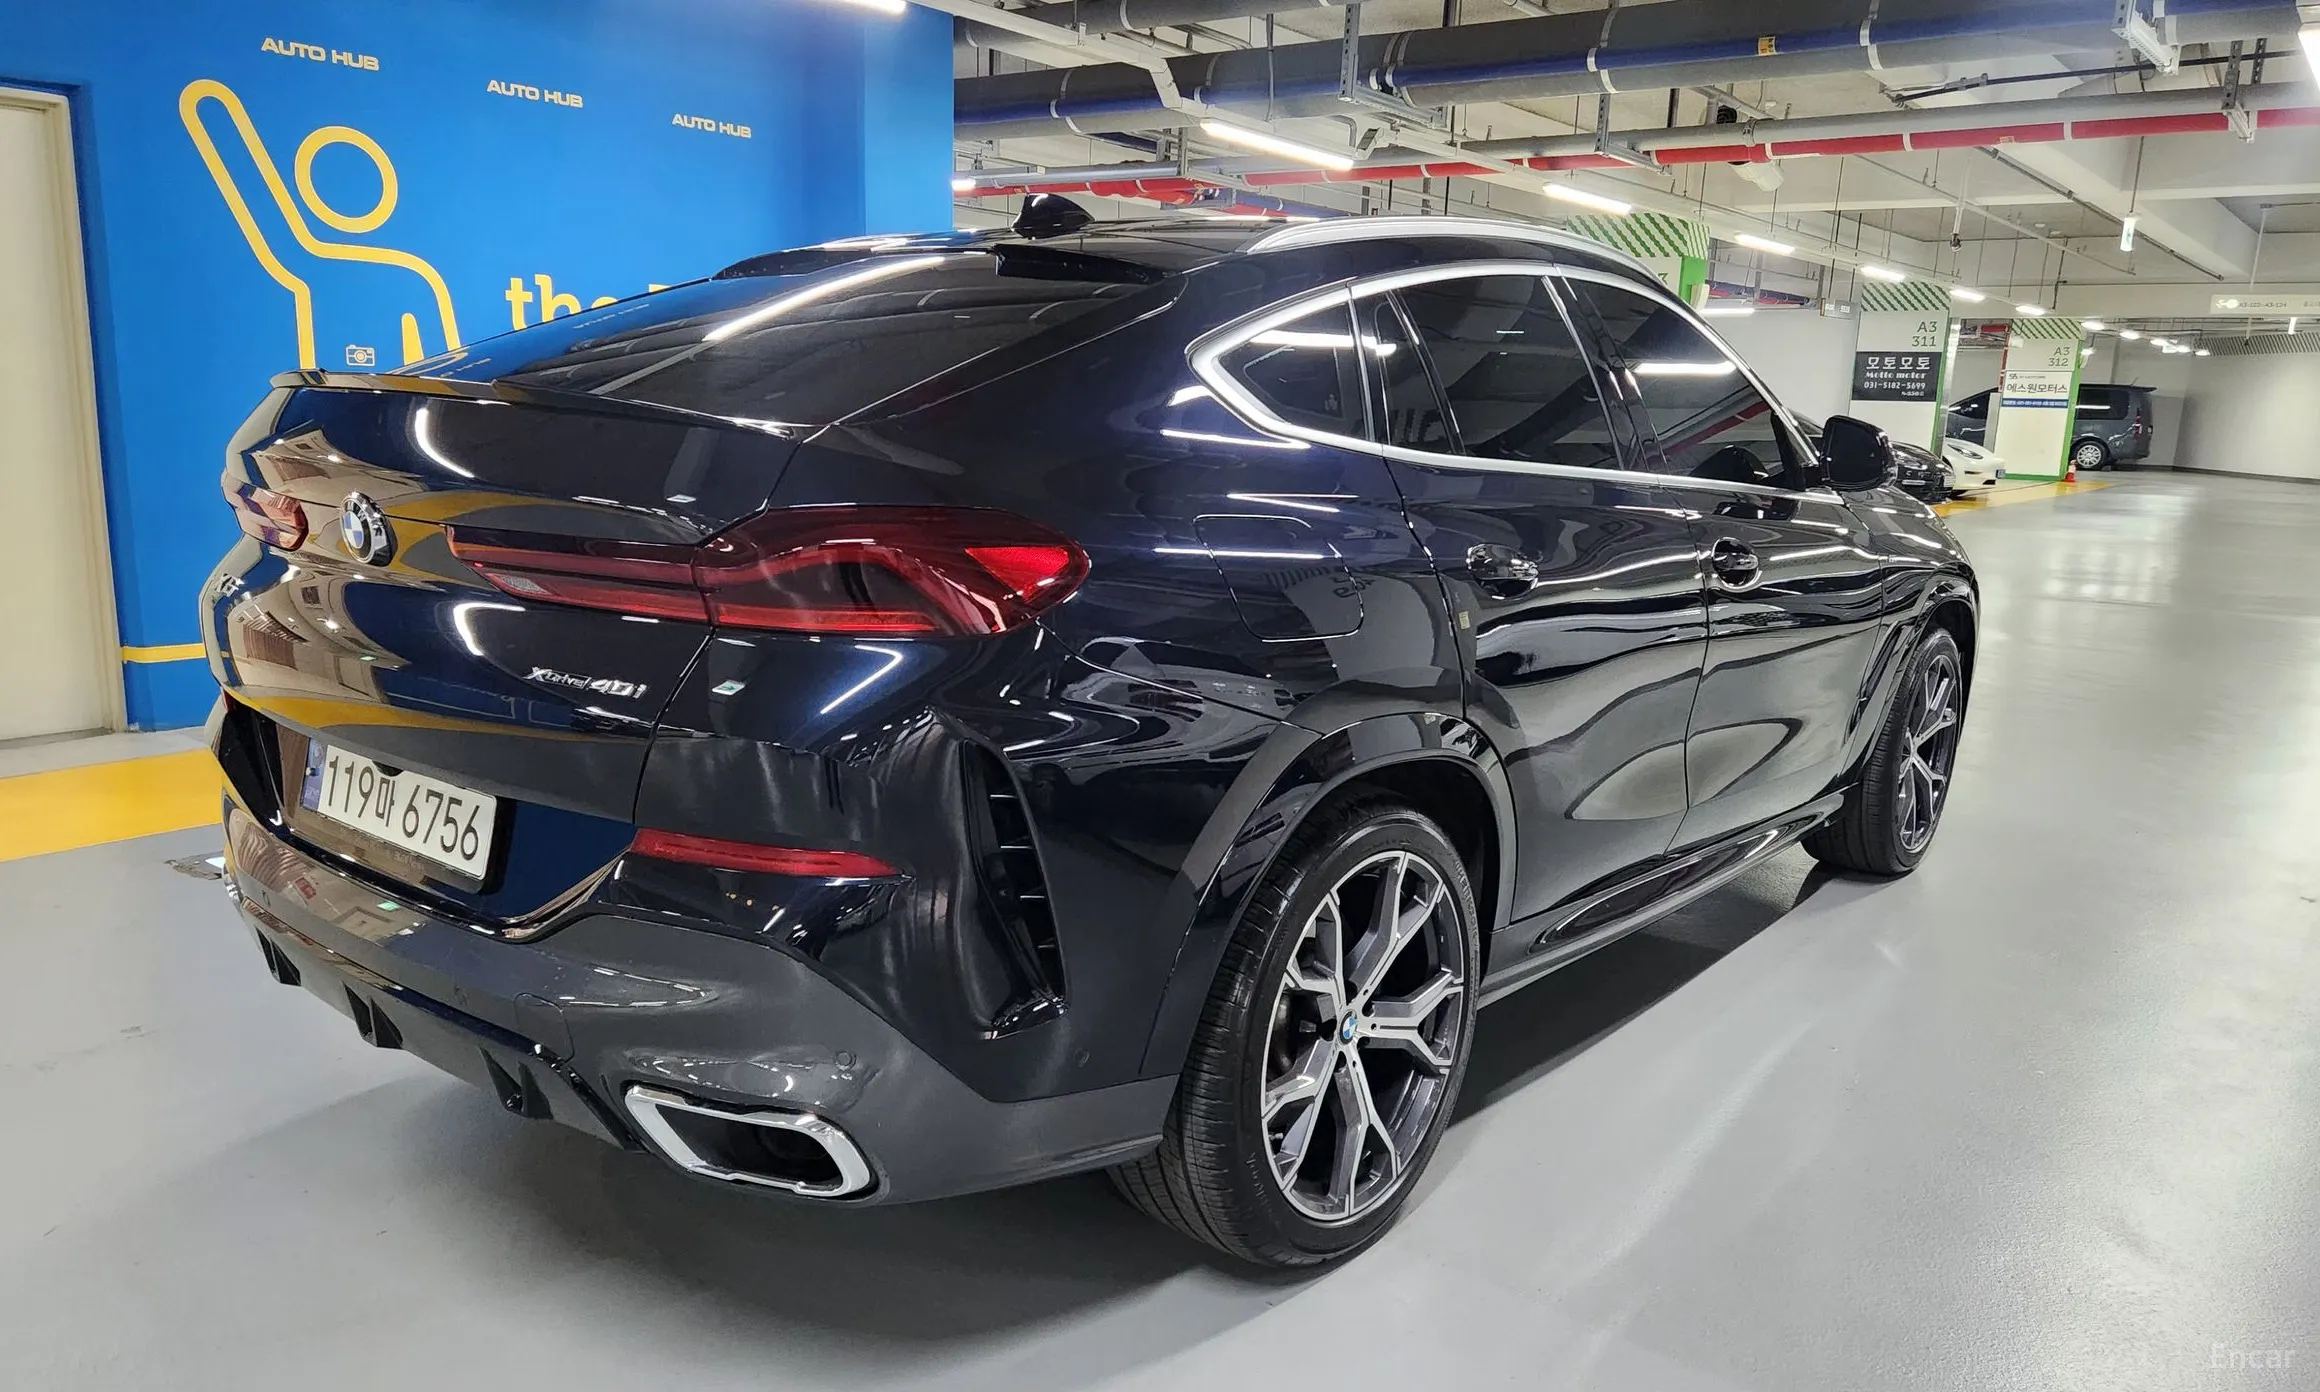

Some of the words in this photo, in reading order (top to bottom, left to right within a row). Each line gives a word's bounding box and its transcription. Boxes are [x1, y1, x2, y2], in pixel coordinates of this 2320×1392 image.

[261, 37, 327, 62] AUTO
[331, 49, 380, 71] HUB
[487, 79, 540, 100] AUTO
[544, 89, 584, 109] HUB
[672, 113, 717, 132] AUTO
[719, 121, 752, 139] HUB
[505, 273, 619, 331] th
[1916, 321, 1938, 333] A3
[1911, 335, 1937, 347] 311
[2053, 346, 2071, 356] A3
[2048, 357, 2069, 367] 312
[2006, 383, 2069, 394] 에스원모터스
[327, 755, 396, 828] 119마
[402, 784, 481, 862] 6756
